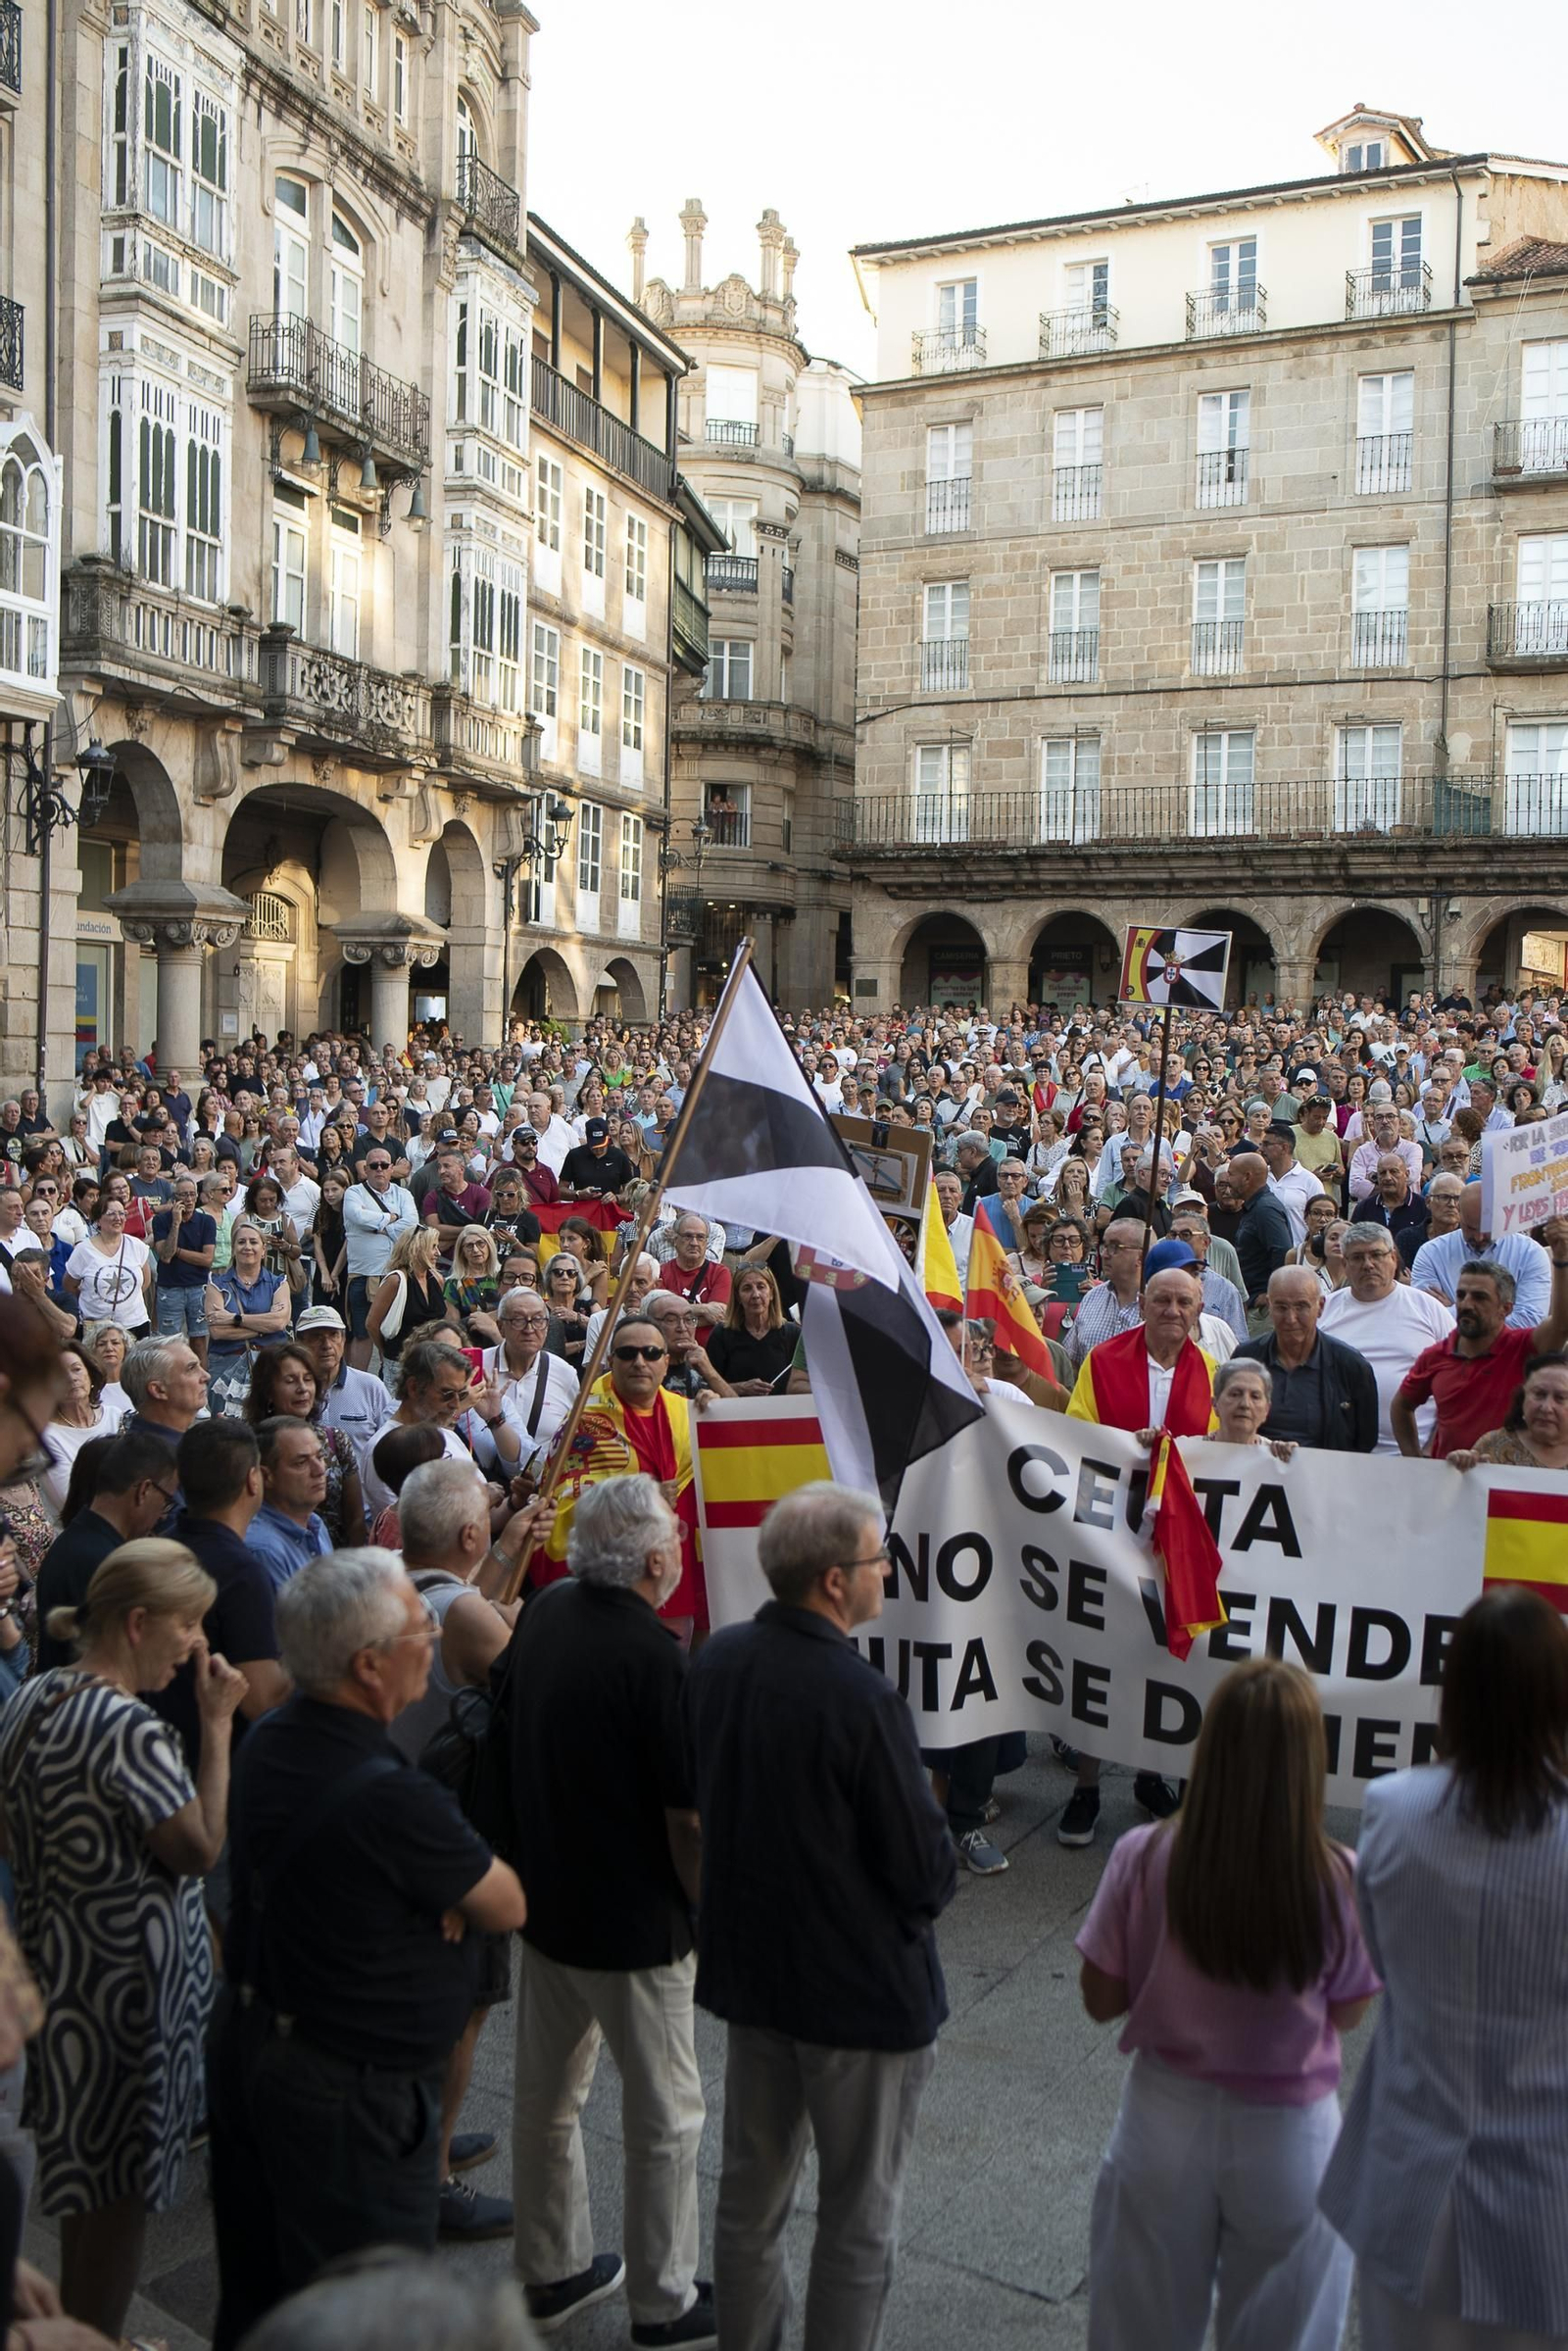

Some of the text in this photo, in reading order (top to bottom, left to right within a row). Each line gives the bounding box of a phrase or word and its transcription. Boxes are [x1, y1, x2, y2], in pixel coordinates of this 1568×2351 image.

[1051, 952, 1083, 960] PRIETO
[1532, 1126, 1546, 1147] LA
[1502, 1203, 1516, 1232] Y
[883, 1532, 993, 1602] NO
[1019, 1543, 1107, 1631] SE
[850, 1636, 999, 1712] UTA
[1021, 1639, 1111, 1730] SE
